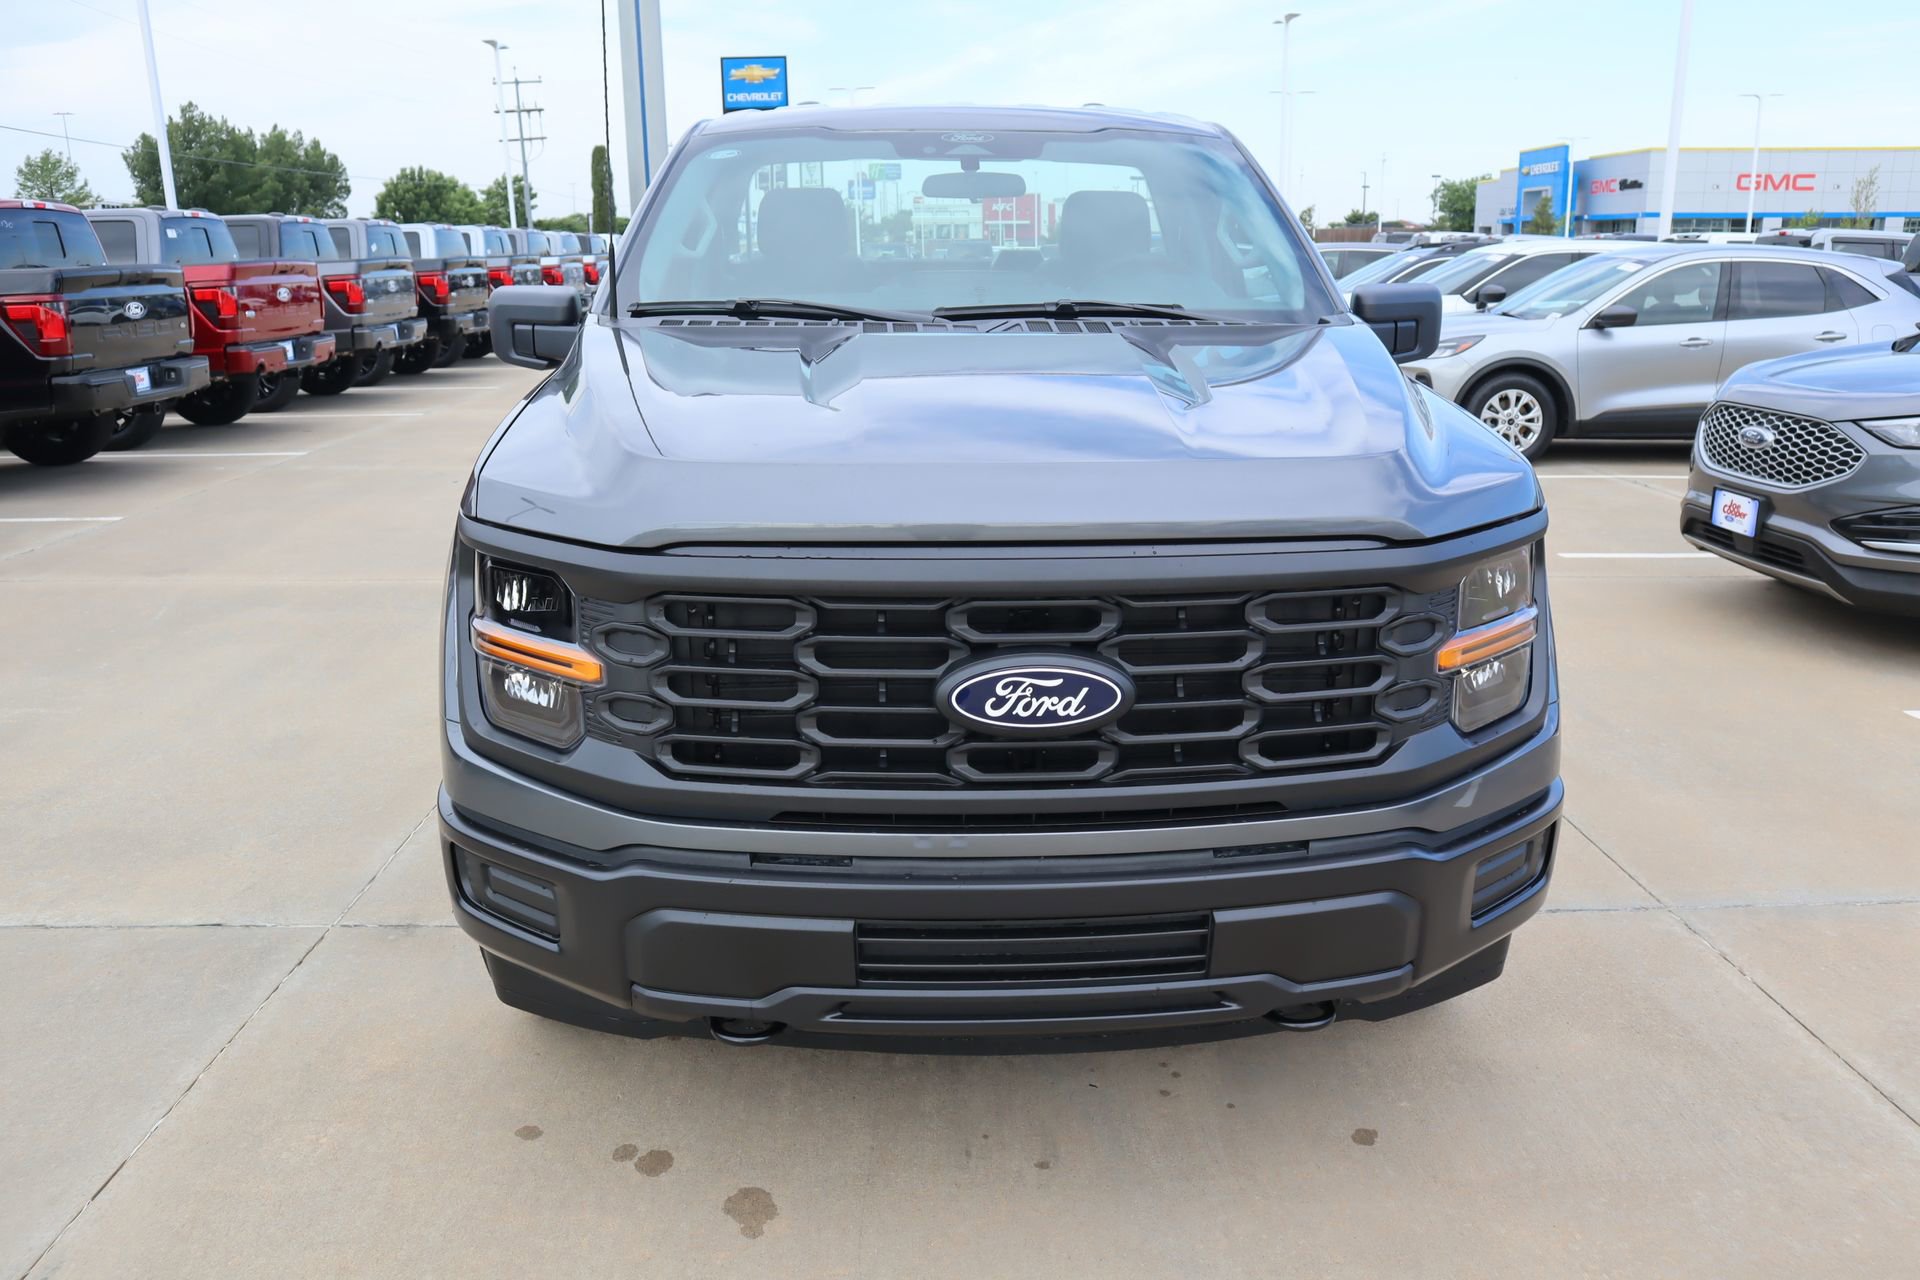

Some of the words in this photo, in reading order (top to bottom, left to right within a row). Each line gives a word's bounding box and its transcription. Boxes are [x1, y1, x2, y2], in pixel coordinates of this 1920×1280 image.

[727, 92, 782, 102] CHEVROLET
[1530, 161, 1560, 176] CHEVROLET
[1591, 178, 1617, 195] GMC
[1736, 173, 1816, 191] GMC
[991, 203, 1014, 211] KFC
[985, 676, 1089, 717] Ford
